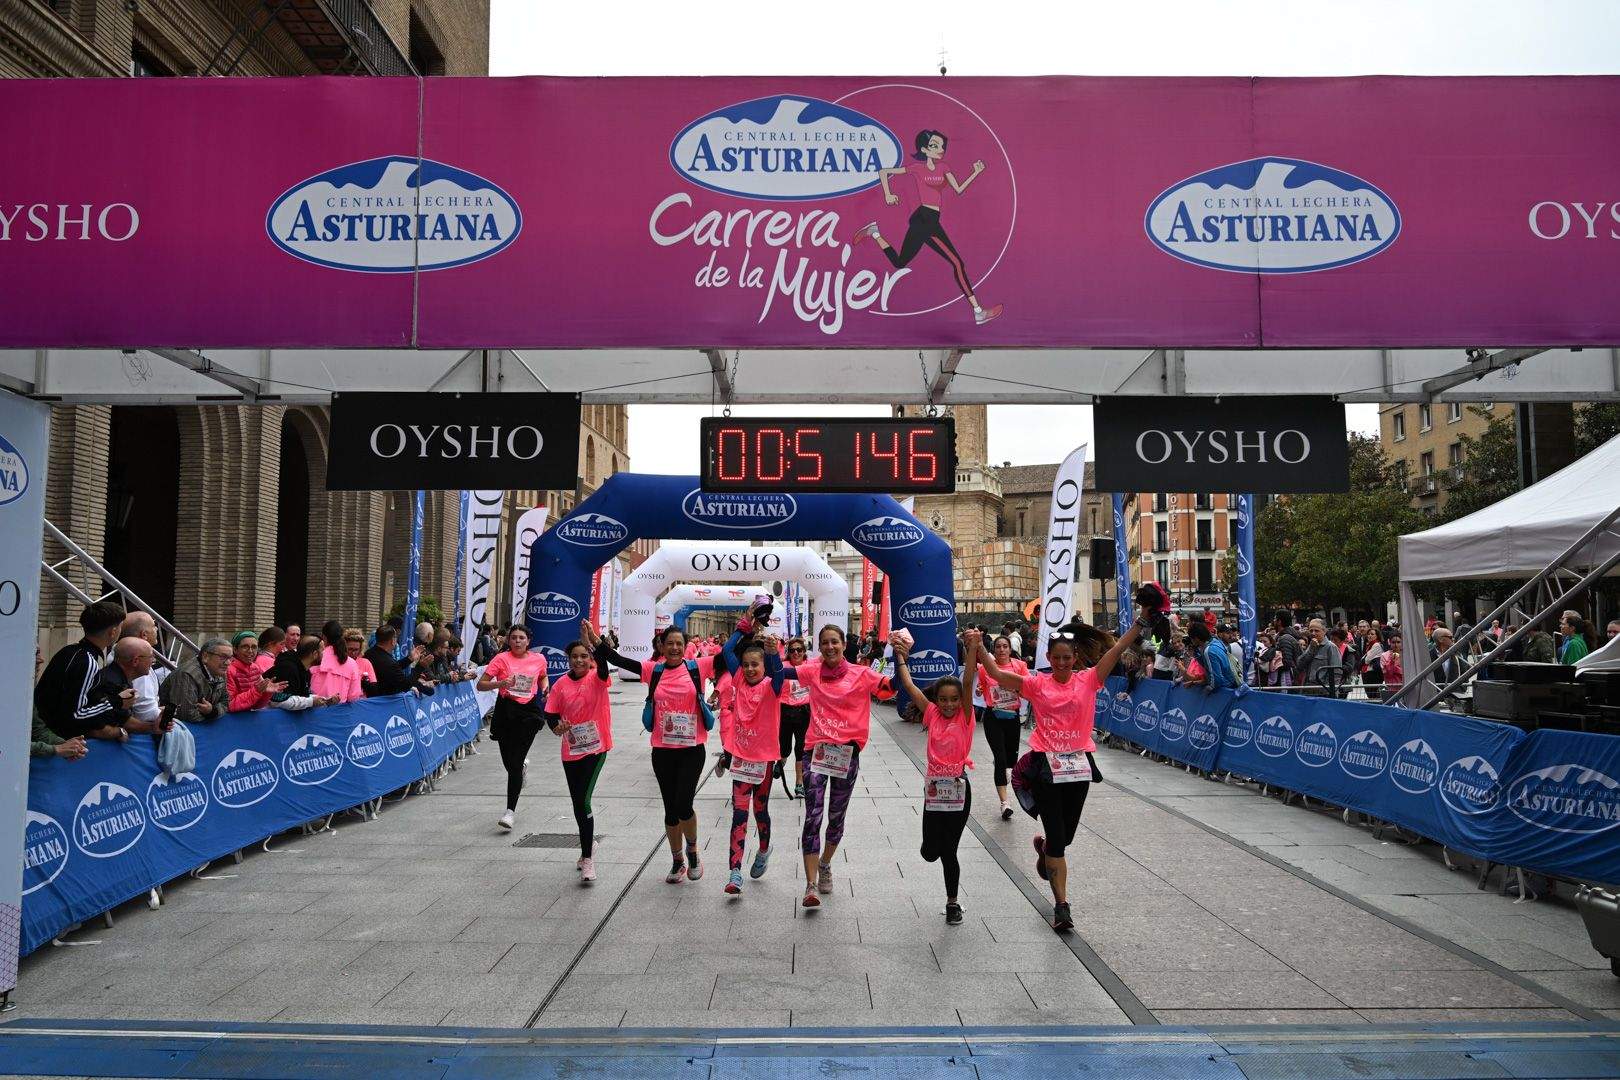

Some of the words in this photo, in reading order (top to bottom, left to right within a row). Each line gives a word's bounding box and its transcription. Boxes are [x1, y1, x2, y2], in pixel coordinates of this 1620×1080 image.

[724, 130, 797, 142] CENTRAL
[805, 130, 877, 142] LECHERA
[687, 134, 884, 174] ASTURIANA
[327, 197, 405, 208] CENTRAL
[413, 196, 494, 208] LECHERA
[1204, 197, 1283, 209] CENTRAL
[1292, 196, 1372, 208] LECHERA
[285, 199, 502, 242] ASTURIANA
[648, 192, 840, 248] Carrera
[1165, 200, 1383, 243] ASTURIANA
[695, 249, 730, 288] de
[738, 248, 765, 288] la
[758, 244, 912, 335] Mujer
[370, 423, 544, 460] OYSHO
[1135, 429, 1311, 464] OYSHO
[691, 495, 788, 517] ASTURIANA
[560, 524, 622, 539] ASTURIANA
[858, 529, 921, 542] ASTURIANA
[691, 553, 781, 572] OYSHO
[1044, 478, 1080, 628] OYSHO
[637, 572, 665, 580] OYSHO
[528, 601, 576, 616] ASTURIANA
[624, 608, 650, 616] OYSHO
[818, 609, 845, 617] OYSHO
[1256, 728, 1290, 749] ASTURIANA
[1297, 736, 1333, 759] ASTURIANA
[288, 751, 341, 778] ASTURIANA
[1341, 744, 1384, 770] ASTURIANA
[218, 769, 276, 800] ASTURIANA
[152, 790, 206, 820] ASTURIANA
[1512, 784, 1620, 821] ASTURIANA
[80, 808, 144, 848] ASTURIANA
